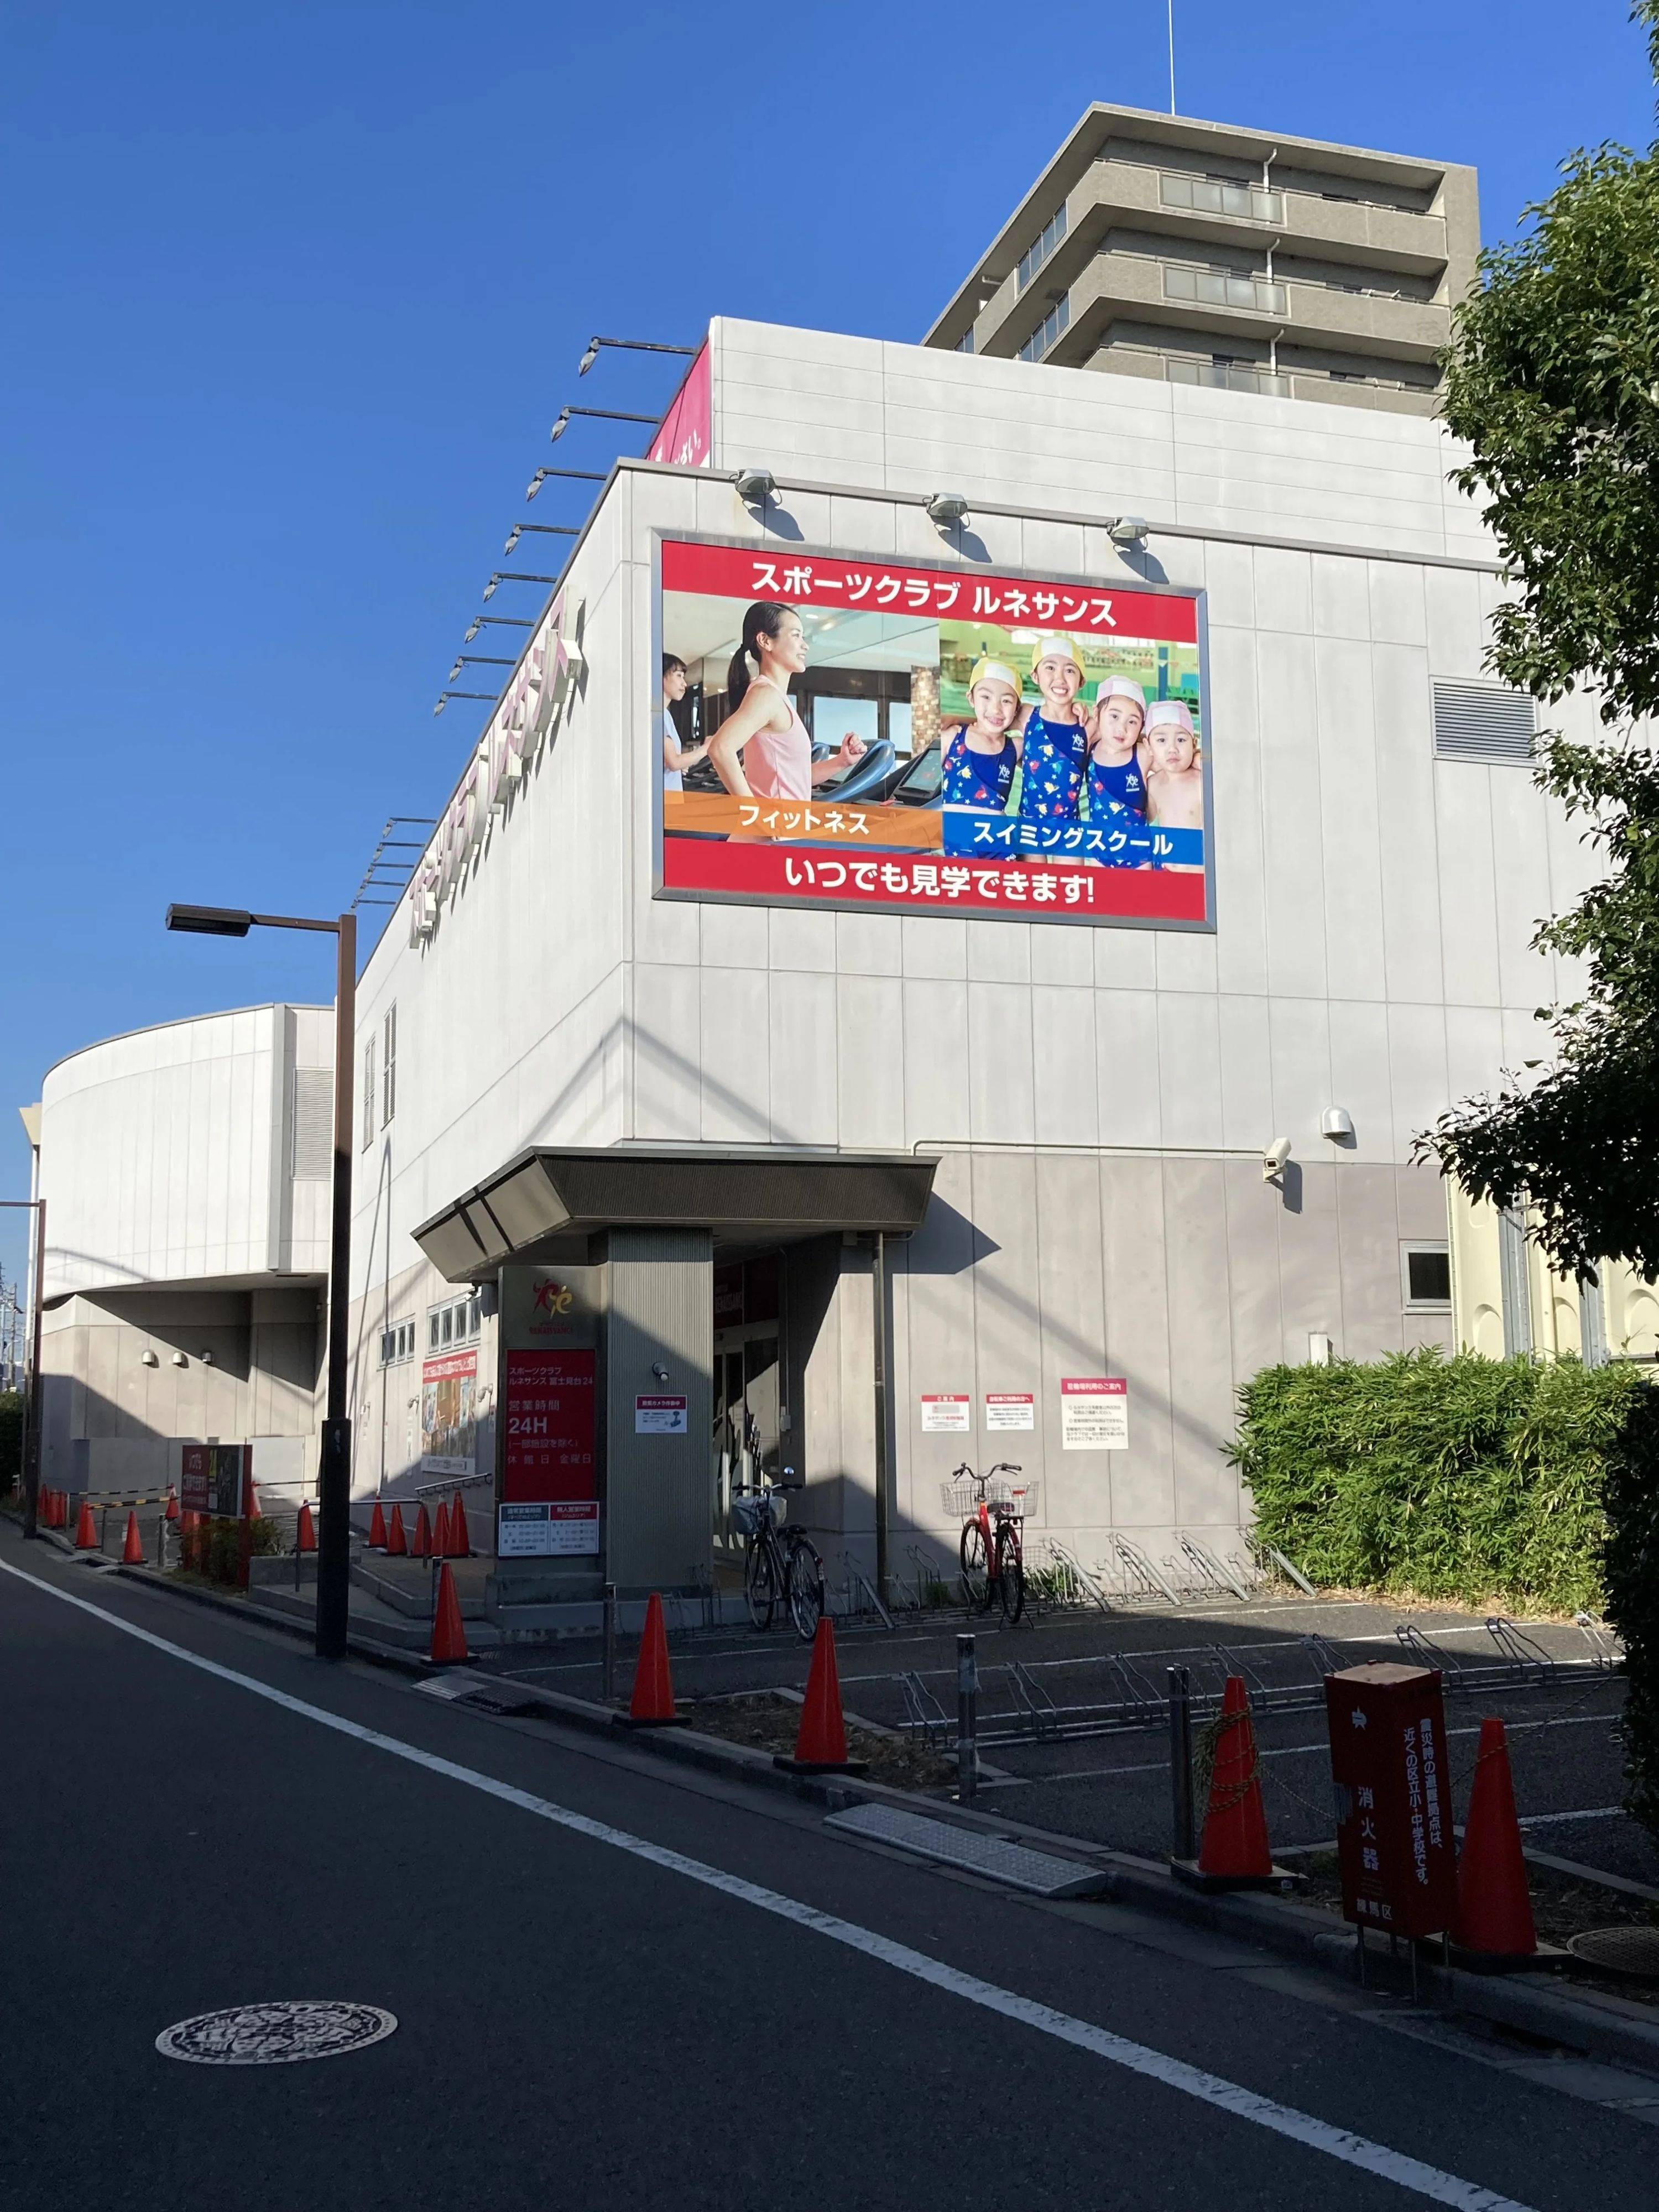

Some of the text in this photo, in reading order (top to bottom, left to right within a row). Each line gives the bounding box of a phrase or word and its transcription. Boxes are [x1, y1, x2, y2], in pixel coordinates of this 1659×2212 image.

[752, 562, 1117, 627] スポーツクラブ ルネサンス
[739, 805, 870, 834] フィットネス
[974, 822, 1173, 855] スイミングスクール
[785, 858, 1094, 903] いつでも見学できます!
[508, 1417, 547, 1433] 24H
[509, 1400, 560, 1411] 営業時間
[1420, 1718, 1443, 1848] 震災時の避難拠点は、
[1358, 1786, 1380, 1871] 消火器
[1404, 1727, 1429, 1885] 近くの区立小・中学校です。
